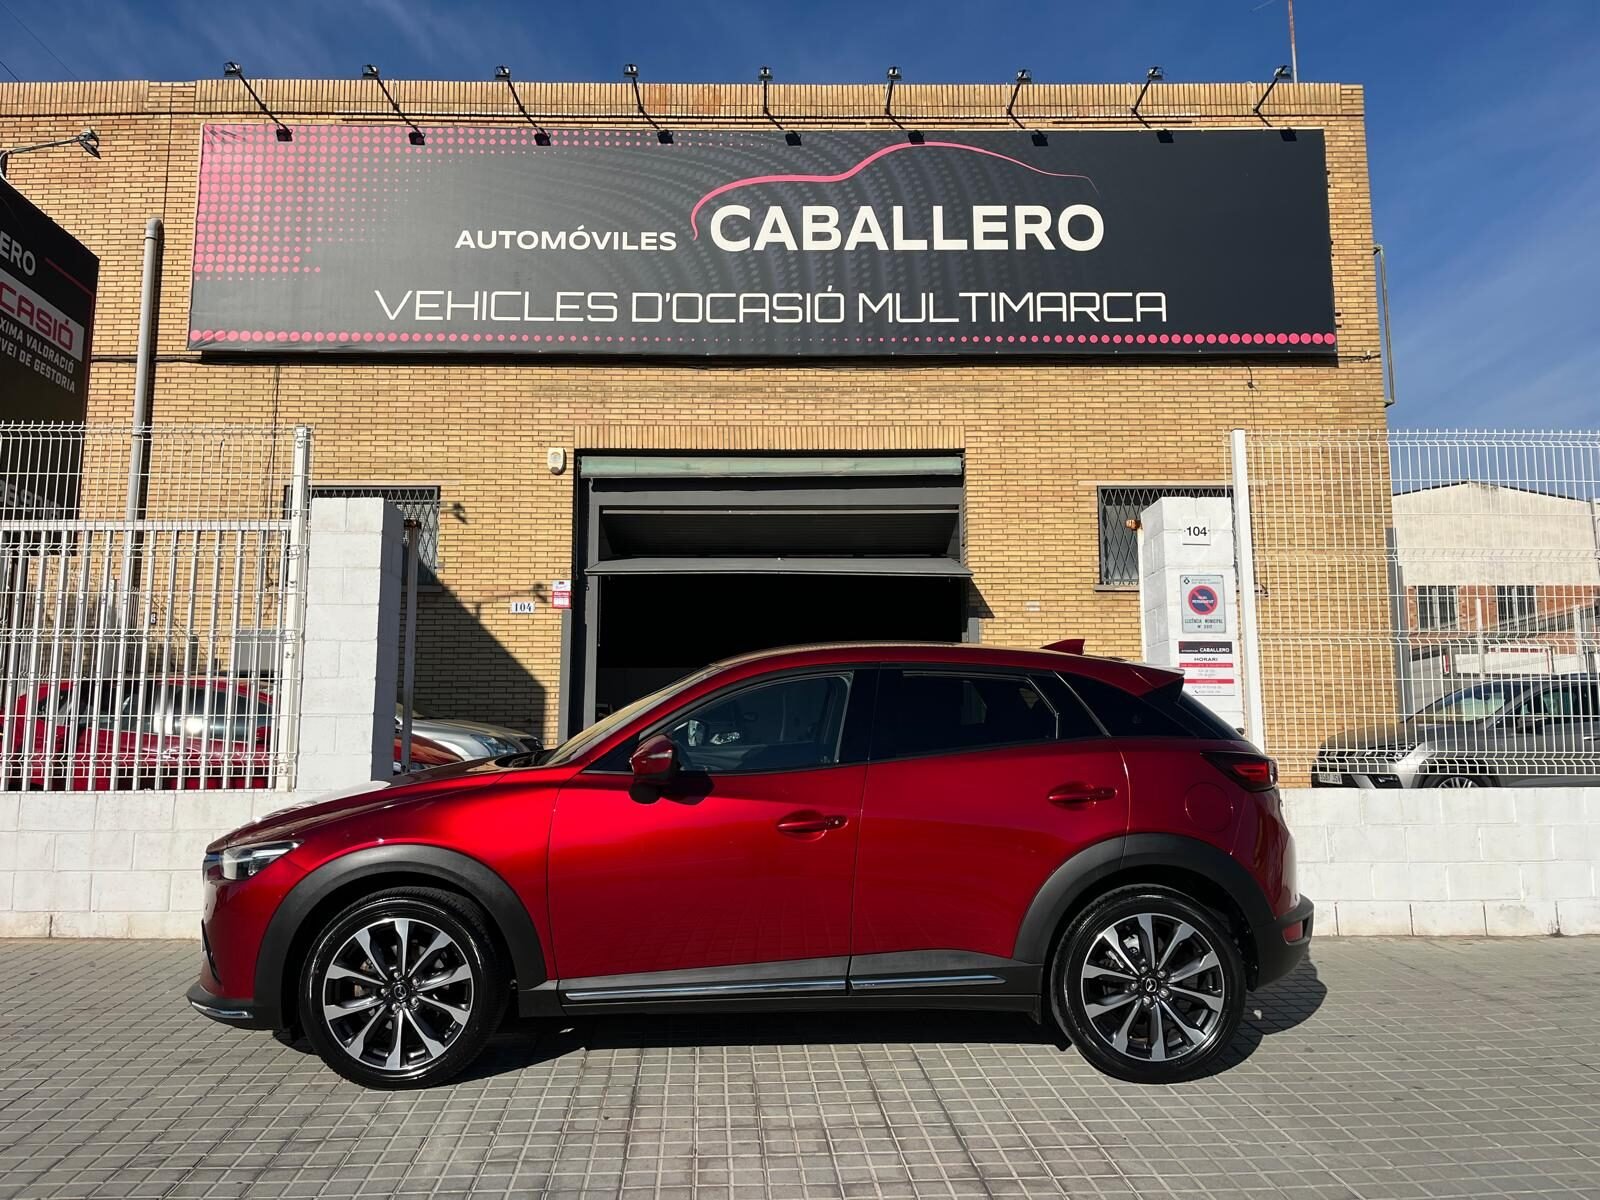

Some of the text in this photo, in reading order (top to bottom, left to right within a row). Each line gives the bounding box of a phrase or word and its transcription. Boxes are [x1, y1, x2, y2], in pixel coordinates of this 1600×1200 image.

[455, 204, 1104, 252] AUTOMÓVILES CABALLERO
[375, 285, 1167, 323] VEHICLES D'OCASIÓ MULTIMARCA
[19, 349, 32, 368] DE
[34, 360, 76, 394] GESTORIA
[27, 333, 75, 375] VALORACIÓ
[1186, 526, 1208, 537] 104
[514, 602, 532, 612] 104
